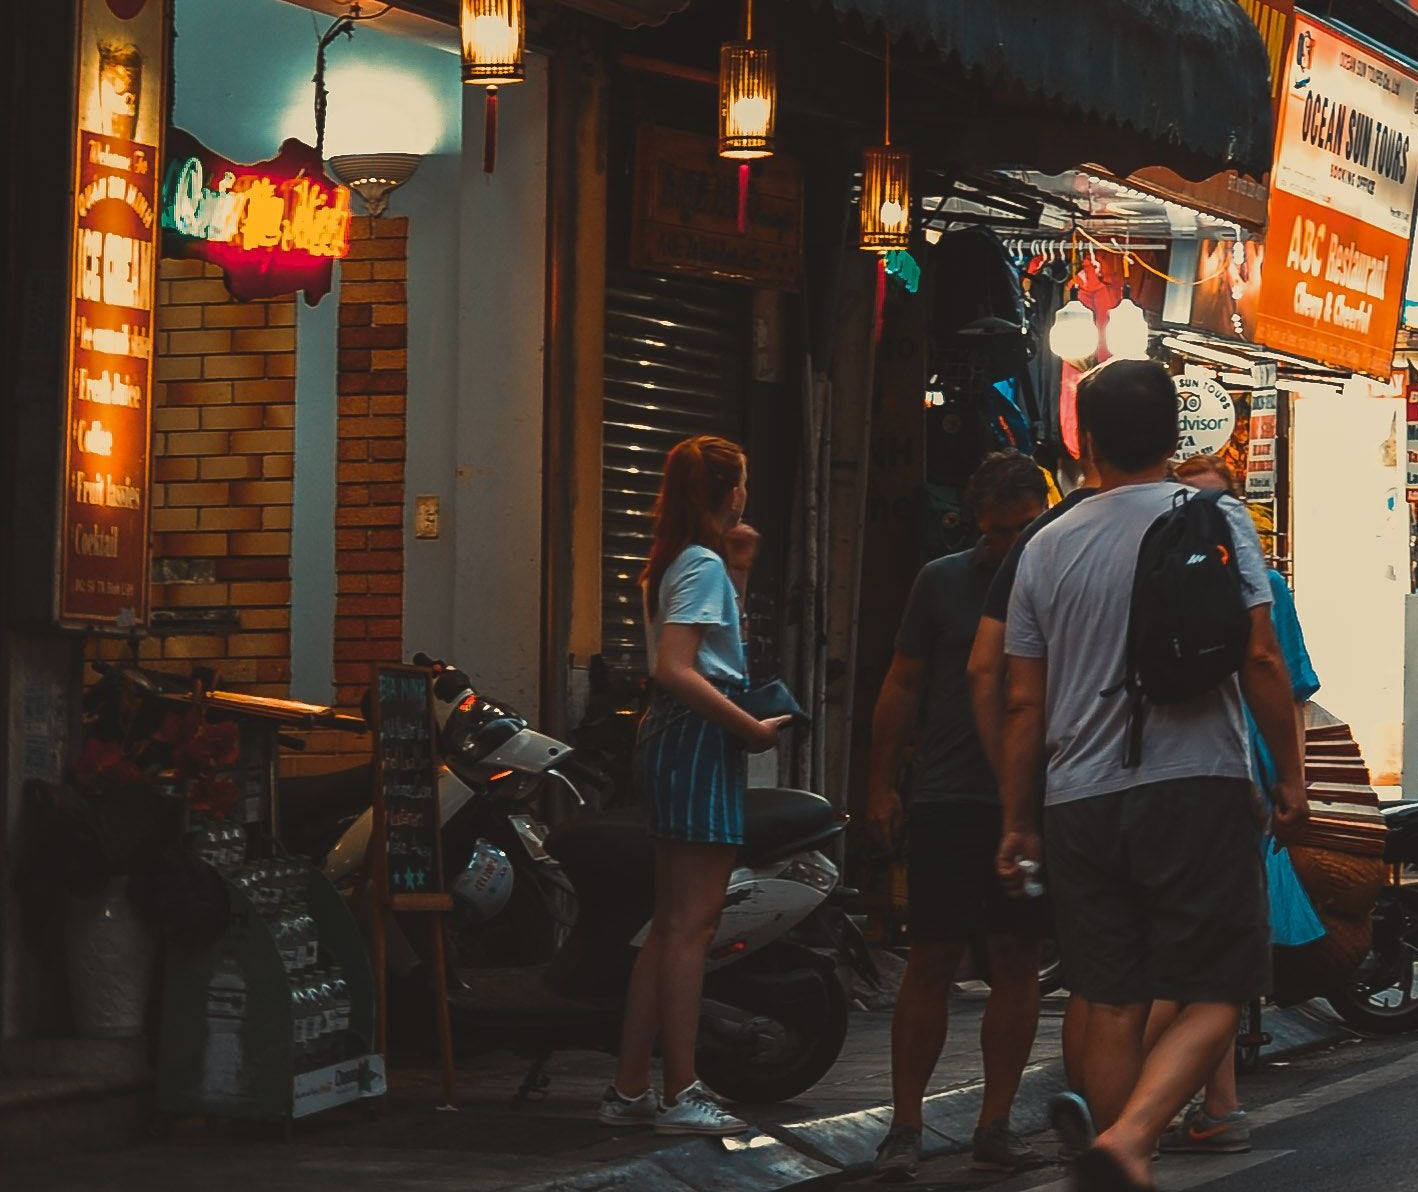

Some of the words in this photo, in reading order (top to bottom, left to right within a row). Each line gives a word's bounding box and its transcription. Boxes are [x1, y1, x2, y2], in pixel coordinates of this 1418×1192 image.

[1302, 90, 1346, 156] OCEAN
[1345, 109, 1374, 168] SUN
[1372, 121, 1410, 184] TOURS
[1286, 214, 1326, 277] ABC
[1325, 232, 1390, 301] Restaurant
[1179, 379, 1199, 387] SUN
[1178, 415, 1224, 430] dvisor
